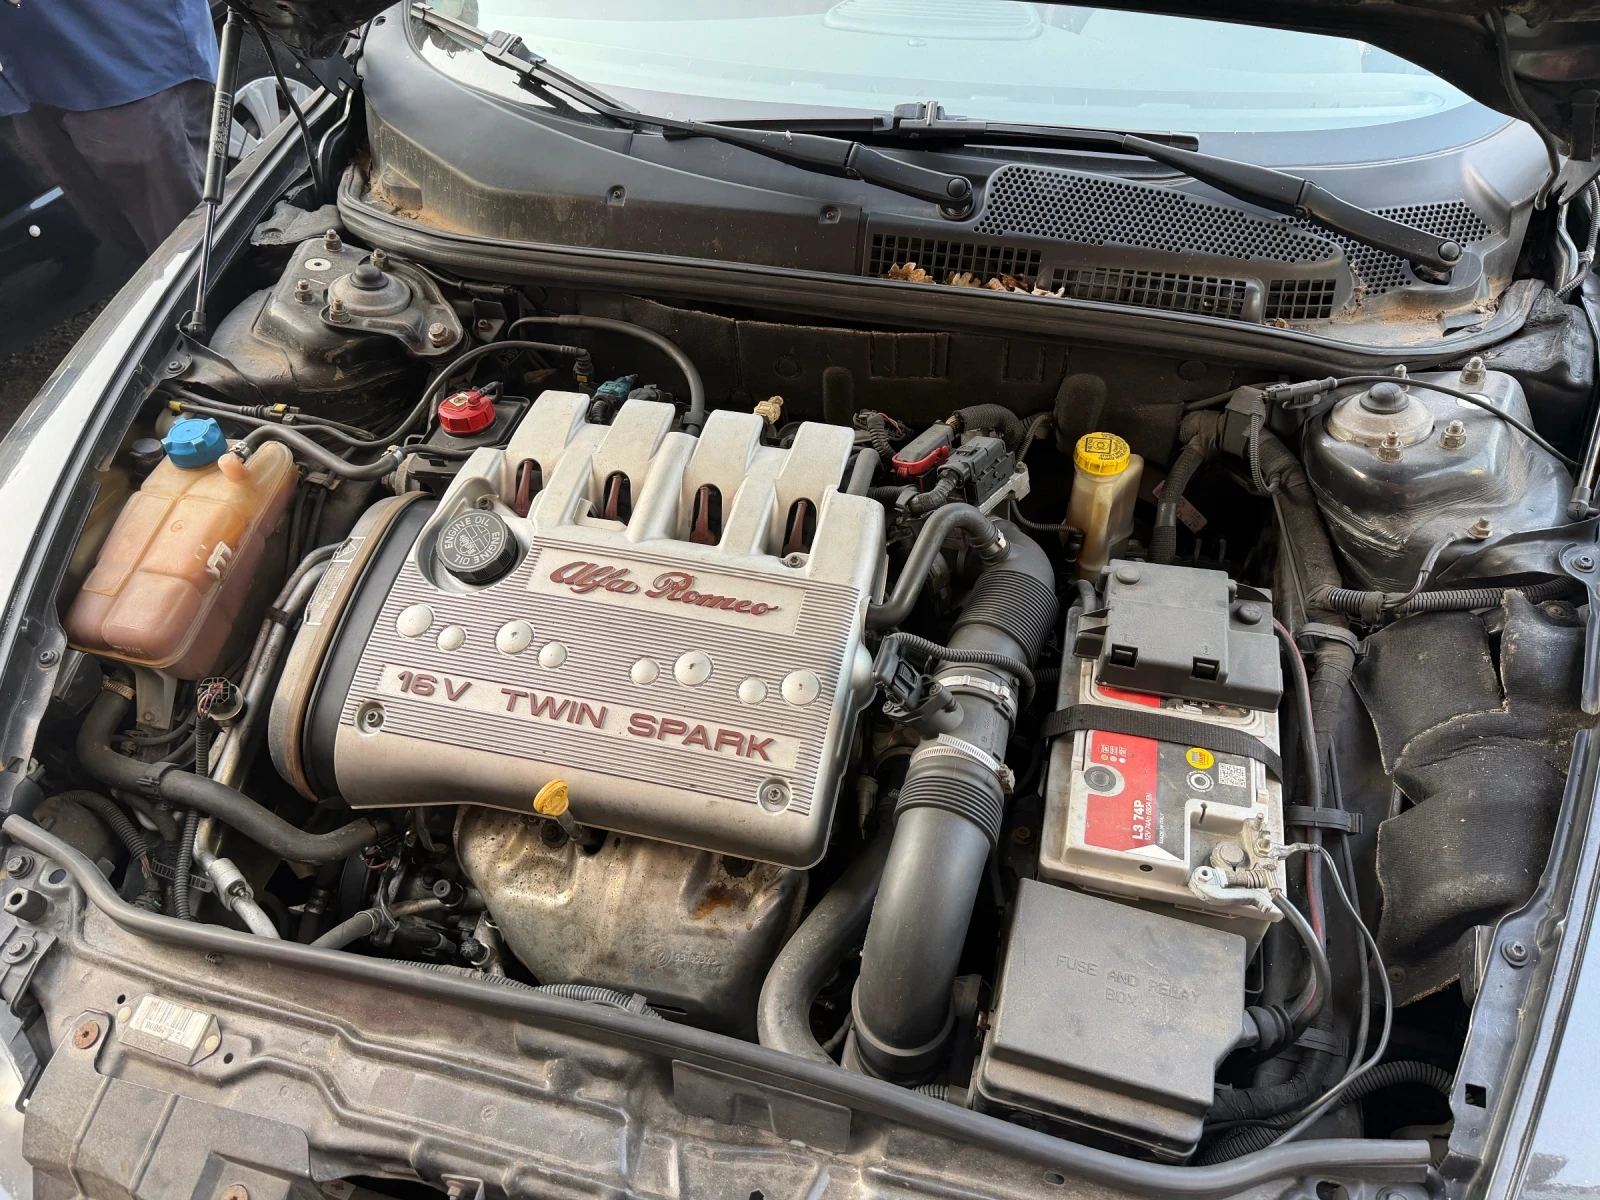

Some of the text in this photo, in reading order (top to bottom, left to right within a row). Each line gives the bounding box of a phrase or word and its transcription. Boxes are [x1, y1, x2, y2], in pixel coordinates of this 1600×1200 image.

[444, 517, 472, 549] ENGINE
[474, 516, 490, 527] OIL
[473, 531, 500, 563] ENGINE
[454, 554, 471, 565] OIL
[549, 560, 781, 615] Alfa Romeo
[500, 687, 609, 729] TWIN
[627, 712, 775, 762] SPARK
[1132, 800, 1144, 839] L3 74P
[1055, 954, 1202, 1004] FUSE AND RELAY
[1105, 987, 1138, 1008] BOX
